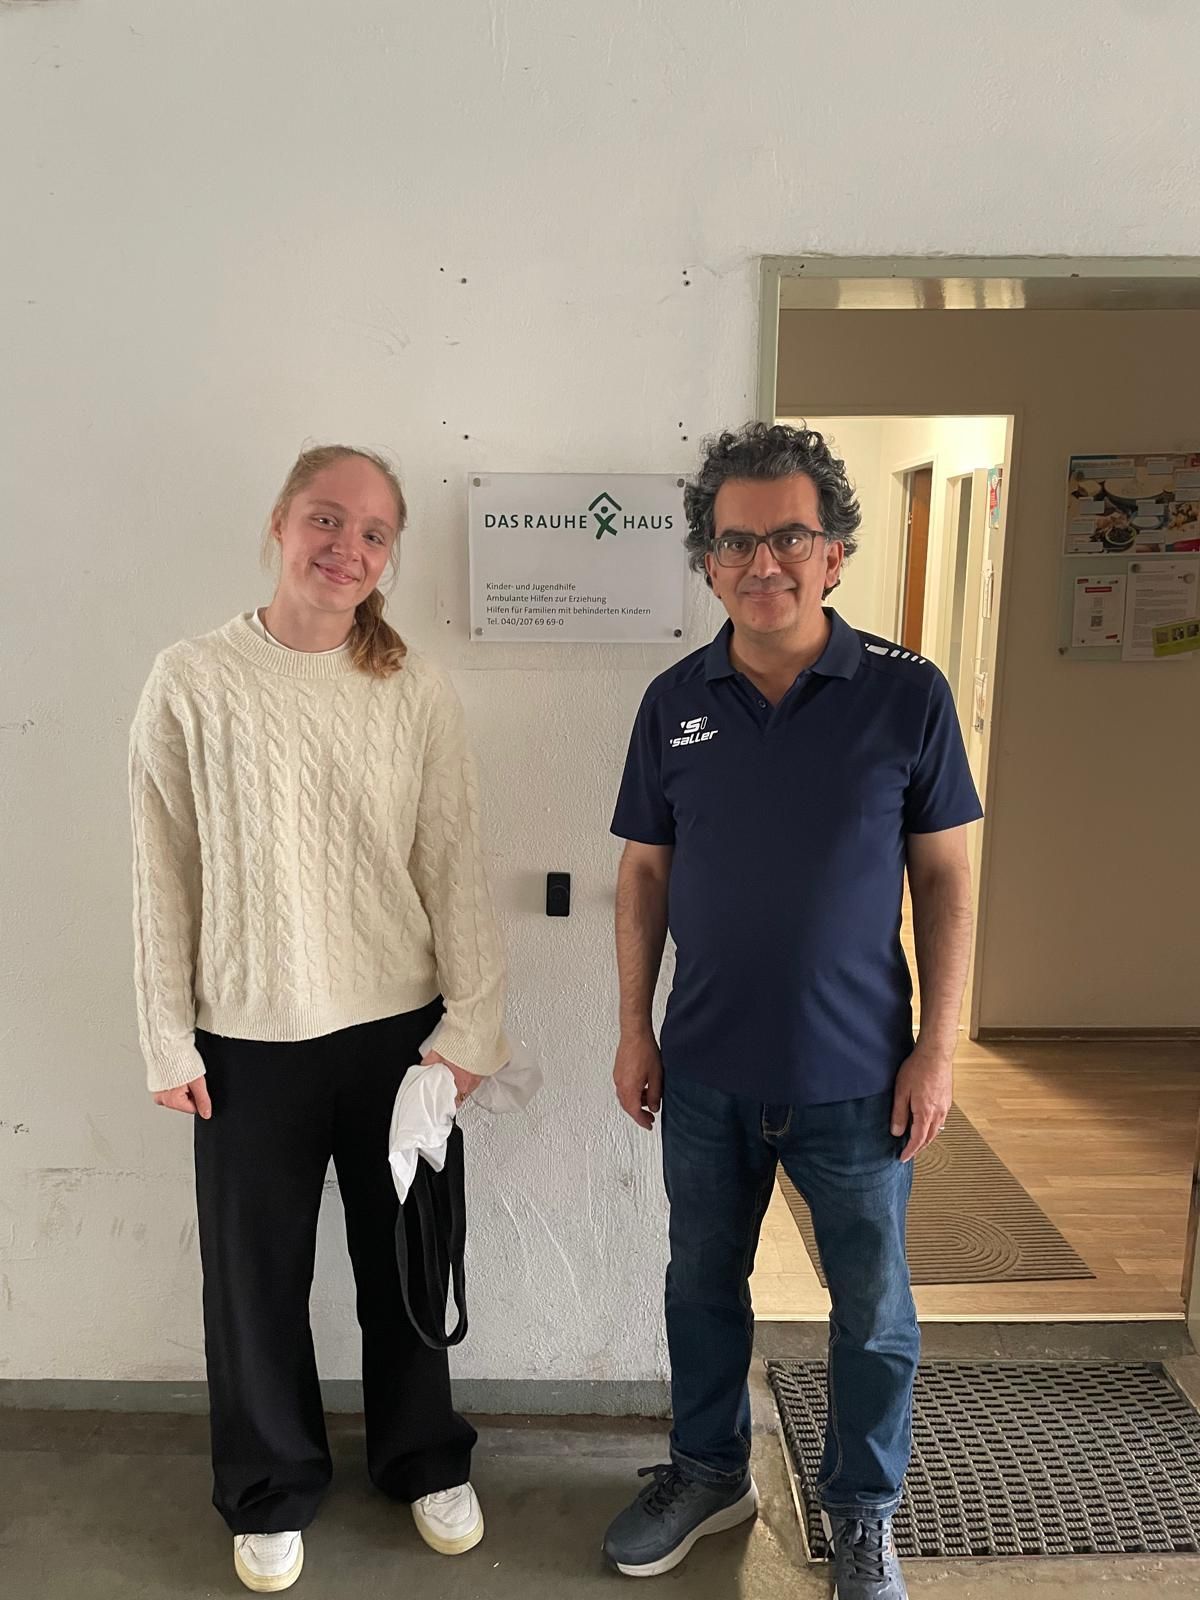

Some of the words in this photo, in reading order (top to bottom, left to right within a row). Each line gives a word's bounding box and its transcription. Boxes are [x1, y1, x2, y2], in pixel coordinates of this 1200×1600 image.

[484, 514, 519, 528] DAS
[524, 514, 588, 529] RAUHE
[623, 515, 673, 529] HAUS
[486, 582, 514, 591] Kinder-
[515, 583, 531, 591] und
[532, 583, 576, 593] Jugendhilfe
[486, 594, 529, 602] Ambulante
[530, 594, 554, 602] Hilfen
[568, 595, 607, 605] Erziehung
[486, 606, 510, 614] Hilfen
[511, 606, 523, 614] für
[524, 606, 557, 614] Familien
[558, 606, 571, 615] mit
[573, 607, 620, 615] behinderten
[621, 607, 651, 615] Kindern
[487, 617, 500, 625] Tel.
[500, 617, 533, 627] 040/207
[534, 618, 545, 626] 69
[546, 618, 564, 626] 69-0
